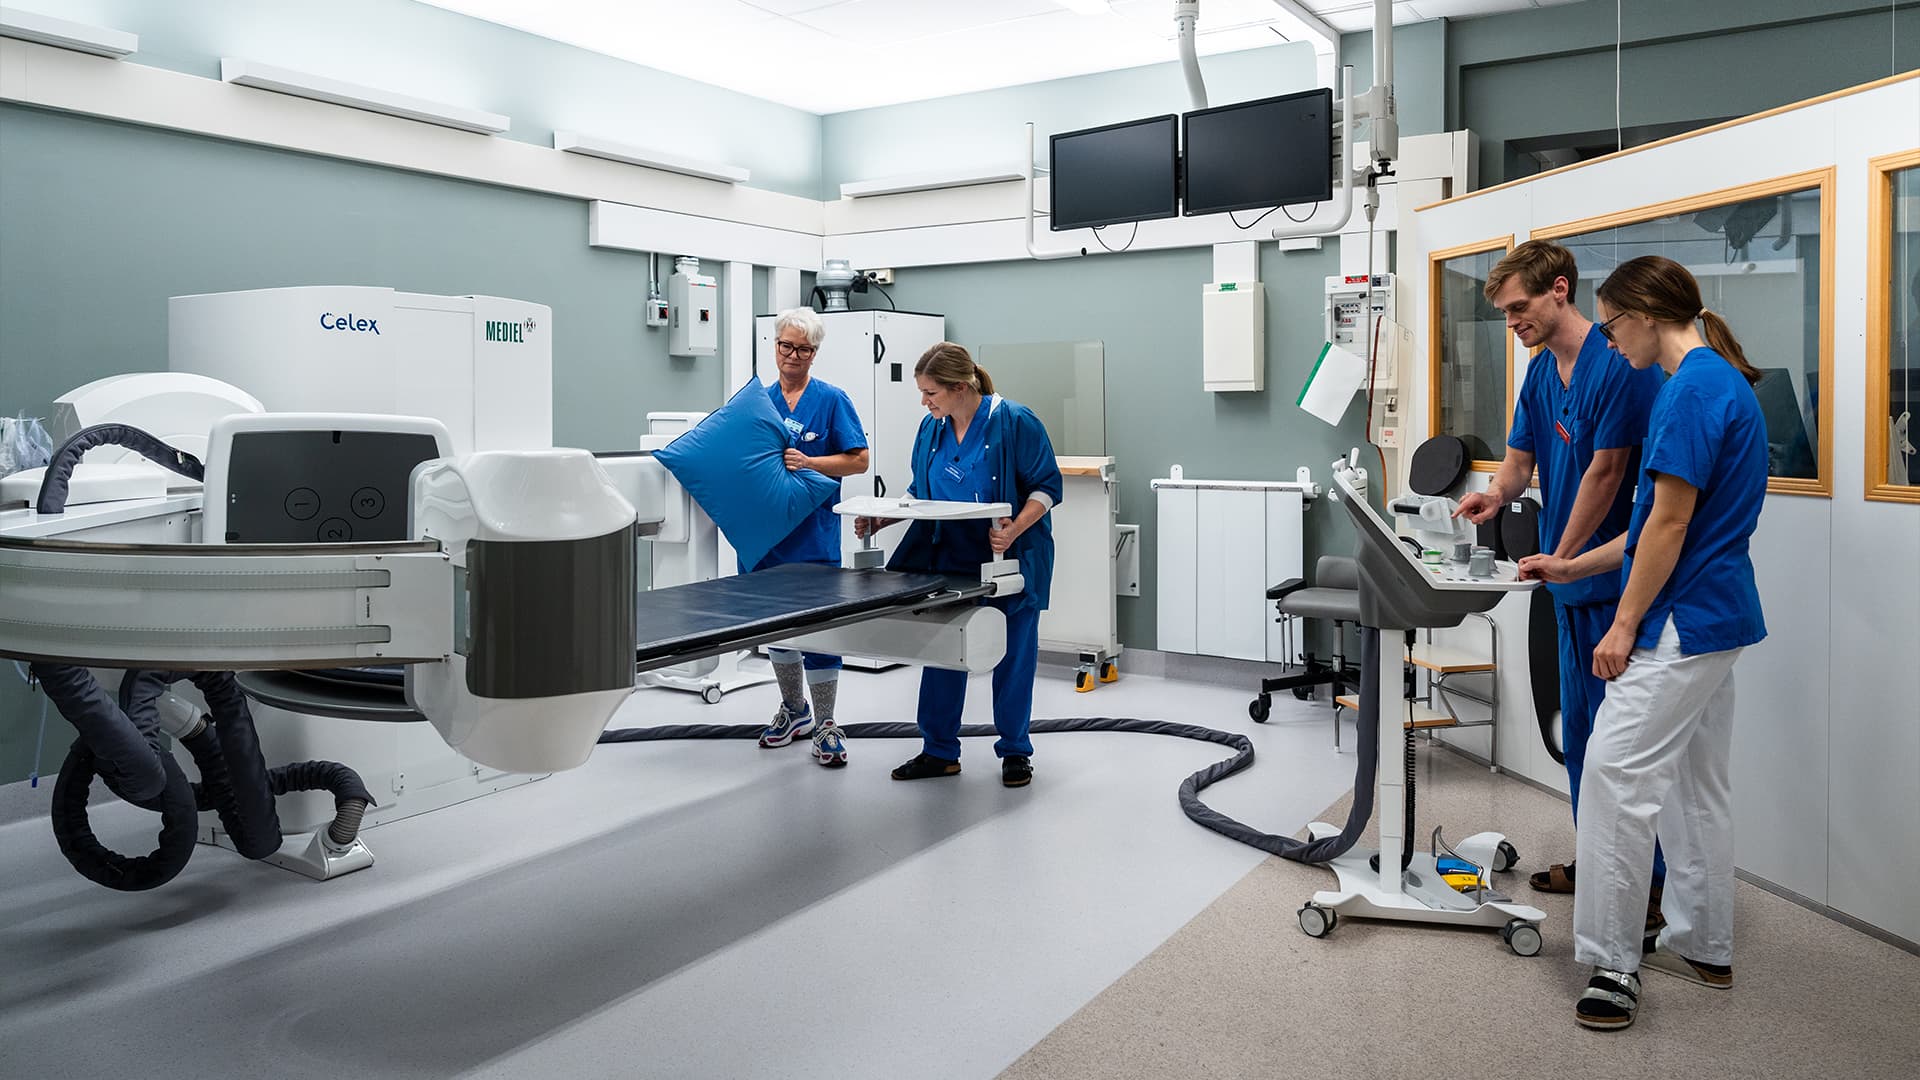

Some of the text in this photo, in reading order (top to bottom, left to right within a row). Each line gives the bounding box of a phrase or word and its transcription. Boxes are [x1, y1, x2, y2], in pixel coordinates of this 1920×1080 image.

[320, 312, 380, 335] Celex
[486, 320, 524, 343] MEDIEL
[360, 498, 376, 507] 3
[327, 529, 343, 538] 2
